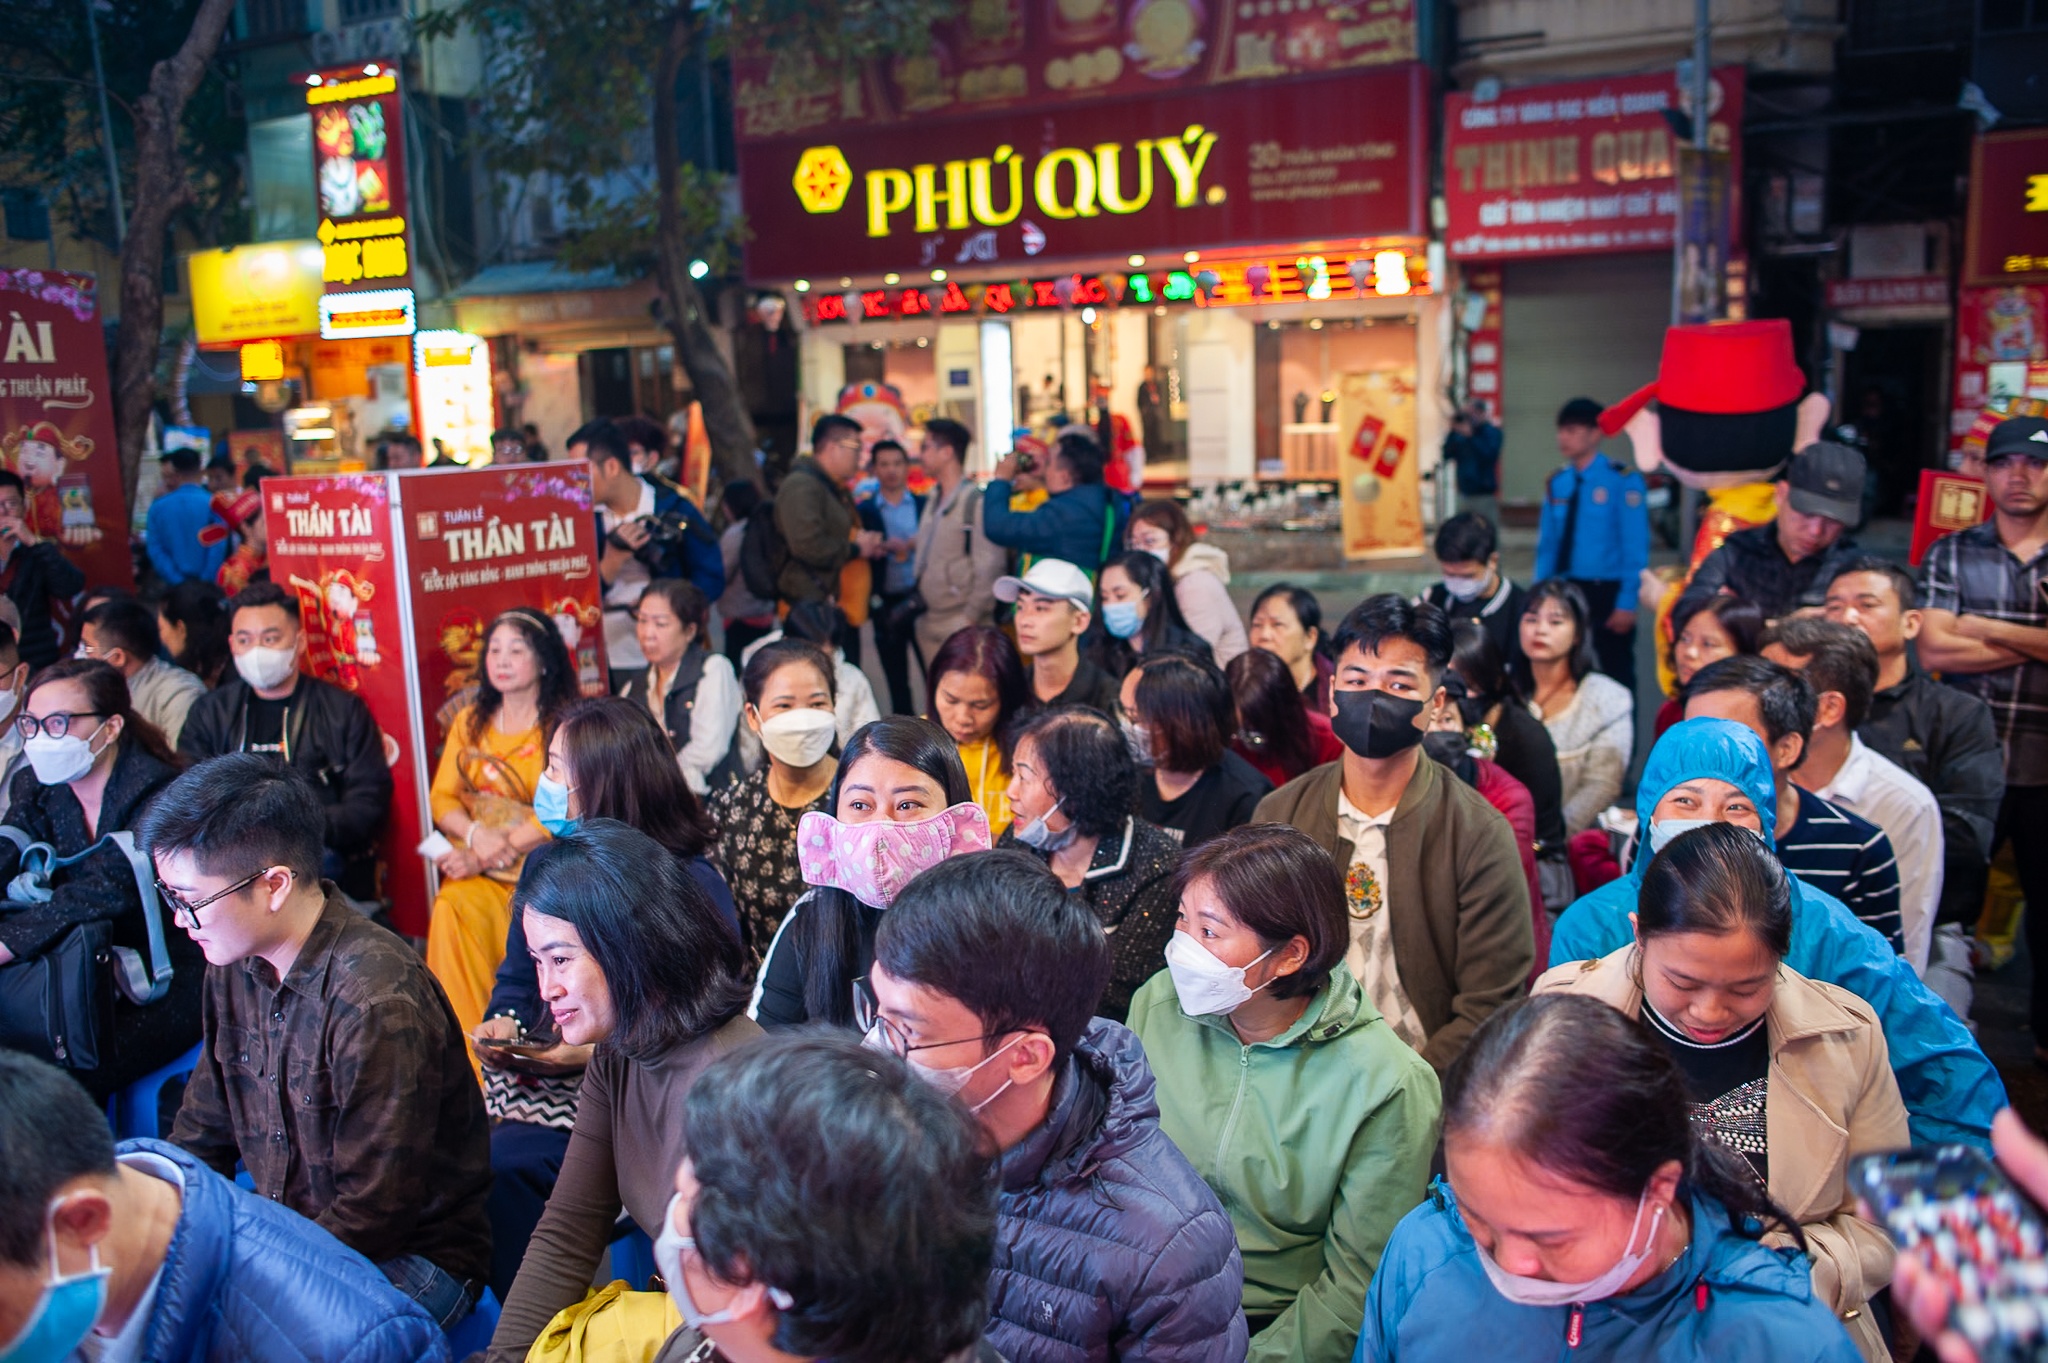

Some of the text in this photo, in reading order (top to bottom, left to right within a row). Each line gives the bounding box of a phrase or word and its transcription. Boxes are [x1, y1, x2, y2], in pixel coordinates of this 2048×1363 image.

[865, 144, 1024, 237] PHÚ
[1454, 135, 1580, 199] THỊNH
[0, 310, 57, 364] ÀI
[54, 373, 87, 397] PHÁT
[286, 501, 335, 538] THẦN
[337, 502, 373, 537] TÀI
[443, 516, 525, 563] THẦN
[530, 512, 575, 552] TÀI
